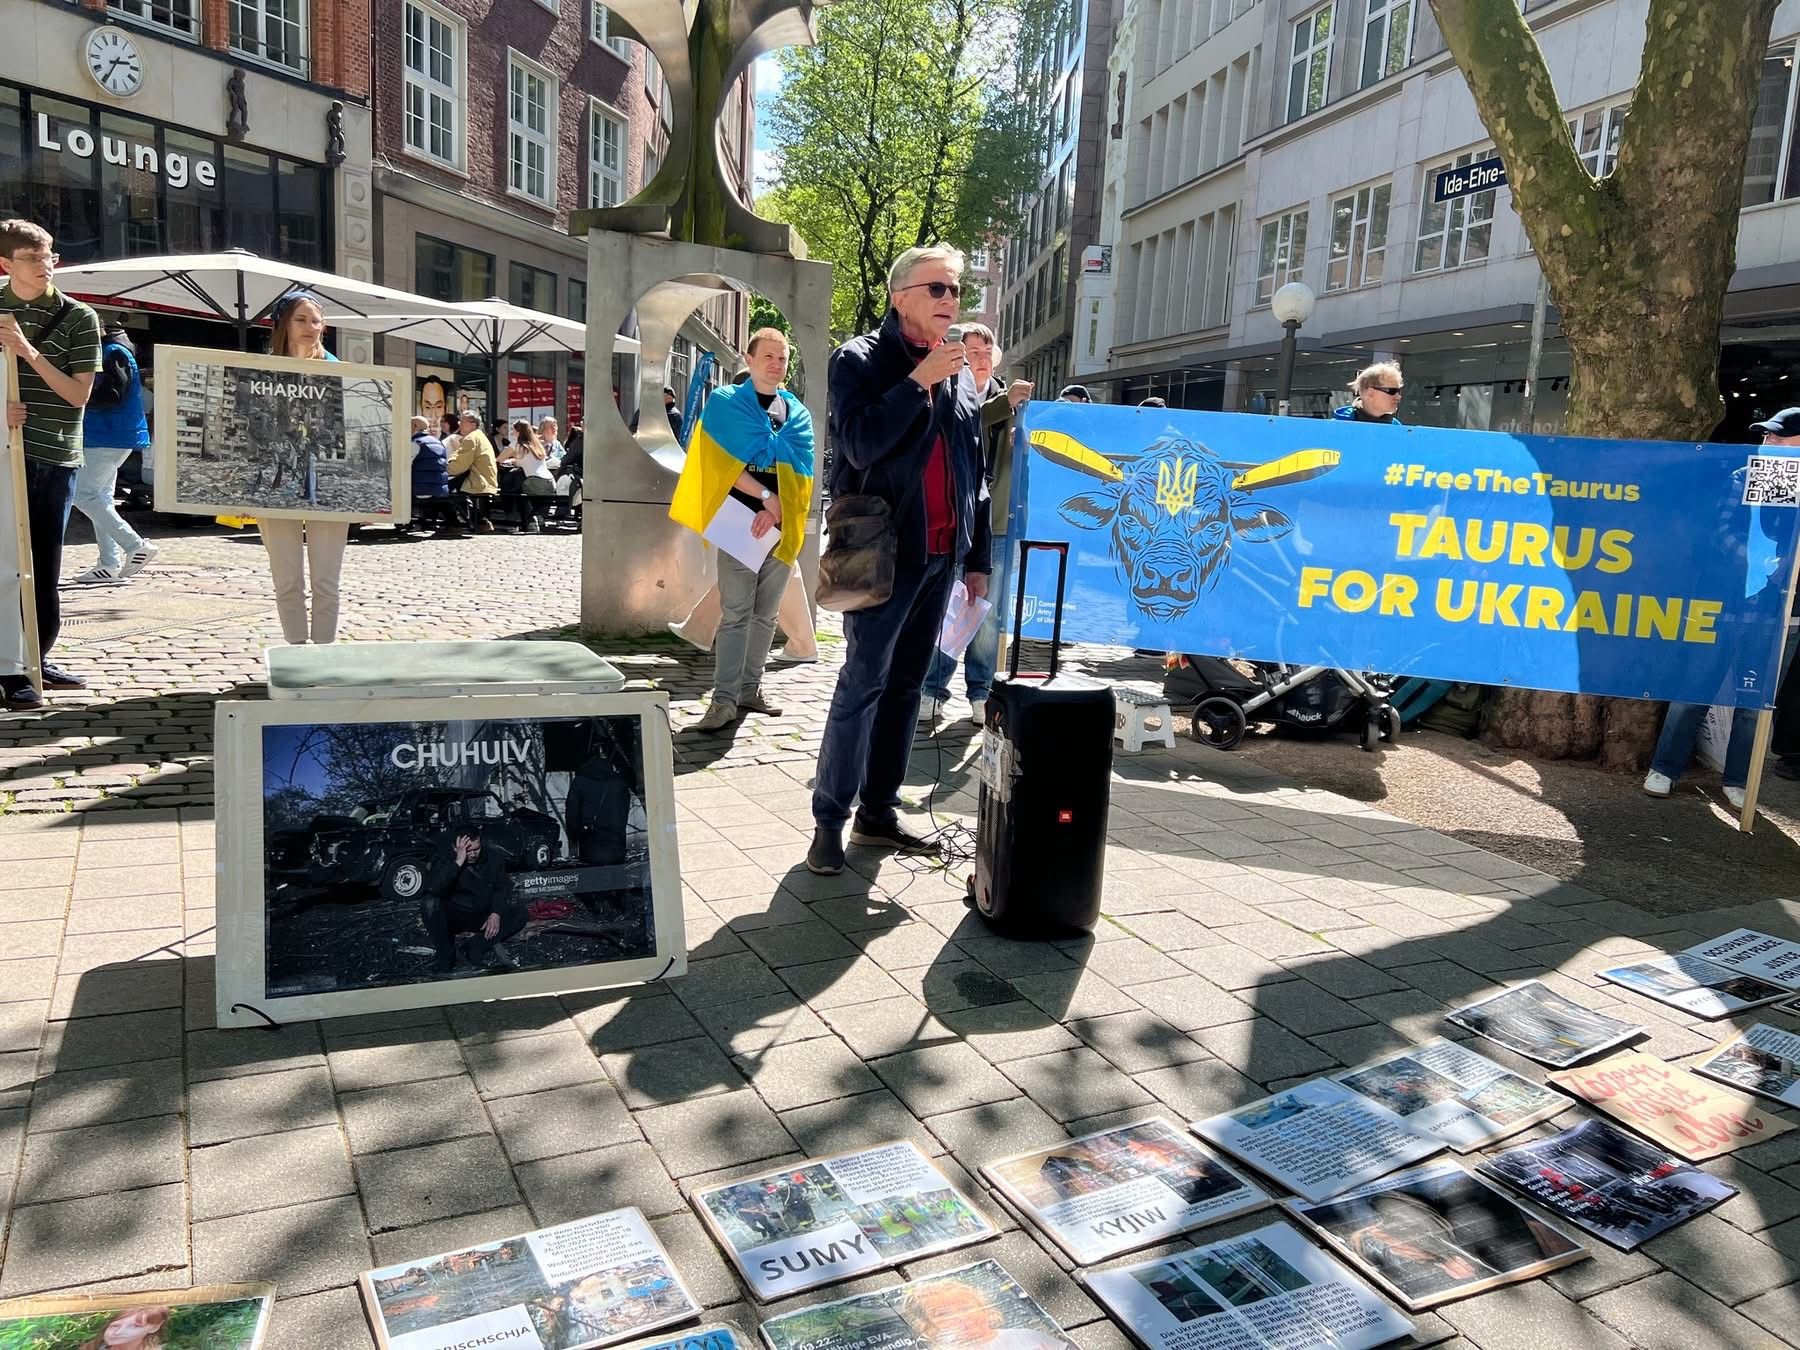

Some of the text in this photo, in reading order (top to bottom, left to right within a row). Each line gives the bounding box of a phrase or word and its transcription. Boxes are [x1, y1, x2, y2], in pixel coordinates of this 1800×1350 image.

[37, 112, 218, 189] Lounge
[1443, 166, 1506, 196] Ida-Ehre-
[249, 378, 327, 401] KHARKIV
[1384, 462, 1640, 503] #FreeTheTaurus
[1389, 513, 1635, 574] TAURUS
[1297, 567, 1723, 644] FOR UKRAINE
[1295, 709, 1322, 722] hauck
[390, 738, 532, 770] CHUHUIV
[523, 871, 579, 888] gettyimages
[1090, 1205, 1168, 1240] KYJIW
[759, 1233, 864, 1281] SUMY
[1160, 1329, 1176, 1338] Die
[1174, 1319, 1210, 1334] Ukraine
[1239, 1306, 1254, 1315] mit
[1254, 1302, 1269, 1310] den
[1234, 1333, 1251, 1342] und
[1330, 1302, 1346, 1311] von
[1346, 1305, 1362, 1314] und
[867, 1332, 892, 1344] EVA
[1164, 1335, 1185, 1345] auch
[1184, 1328, 1206, 1339] Ziele
[1206, 1324, 1221, 1332] auf
[1227, 1327, 1242, 1335] von
